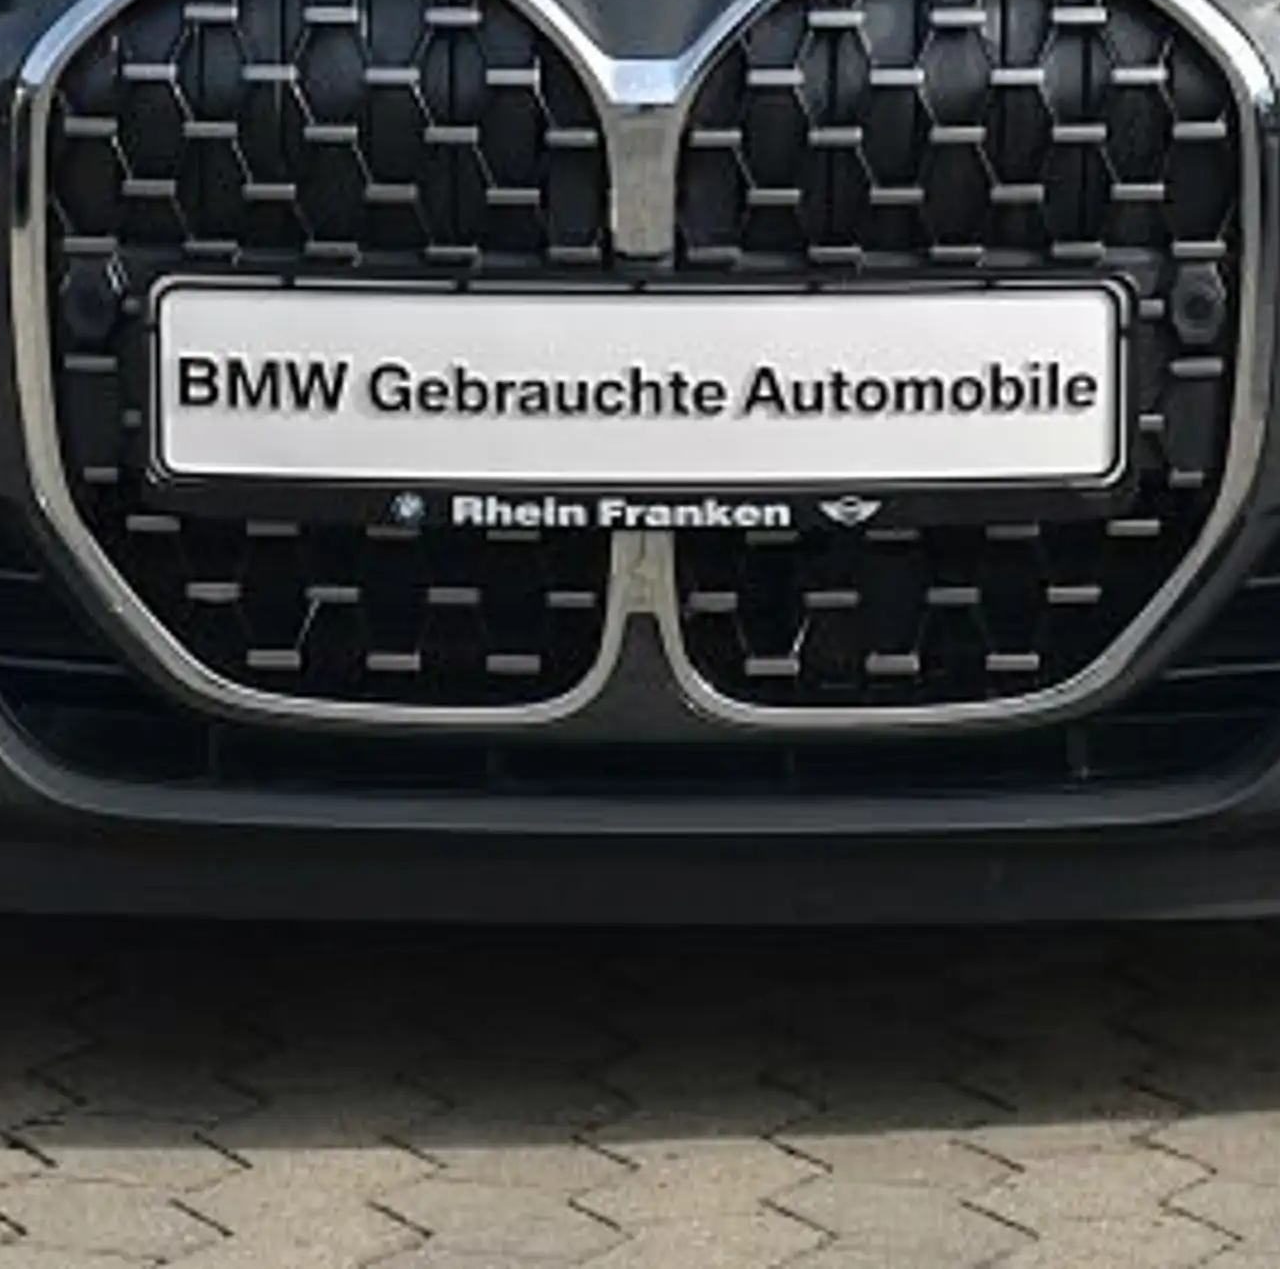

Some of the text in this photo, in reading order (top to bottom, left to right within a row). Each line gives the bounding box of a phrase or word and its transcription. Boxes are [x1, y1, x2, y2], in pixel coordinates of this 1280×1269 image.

[177, 355, 1098, 417] BMW Gebrauchte Automobile
[451, 495, 791, 527] Rhein Franken
